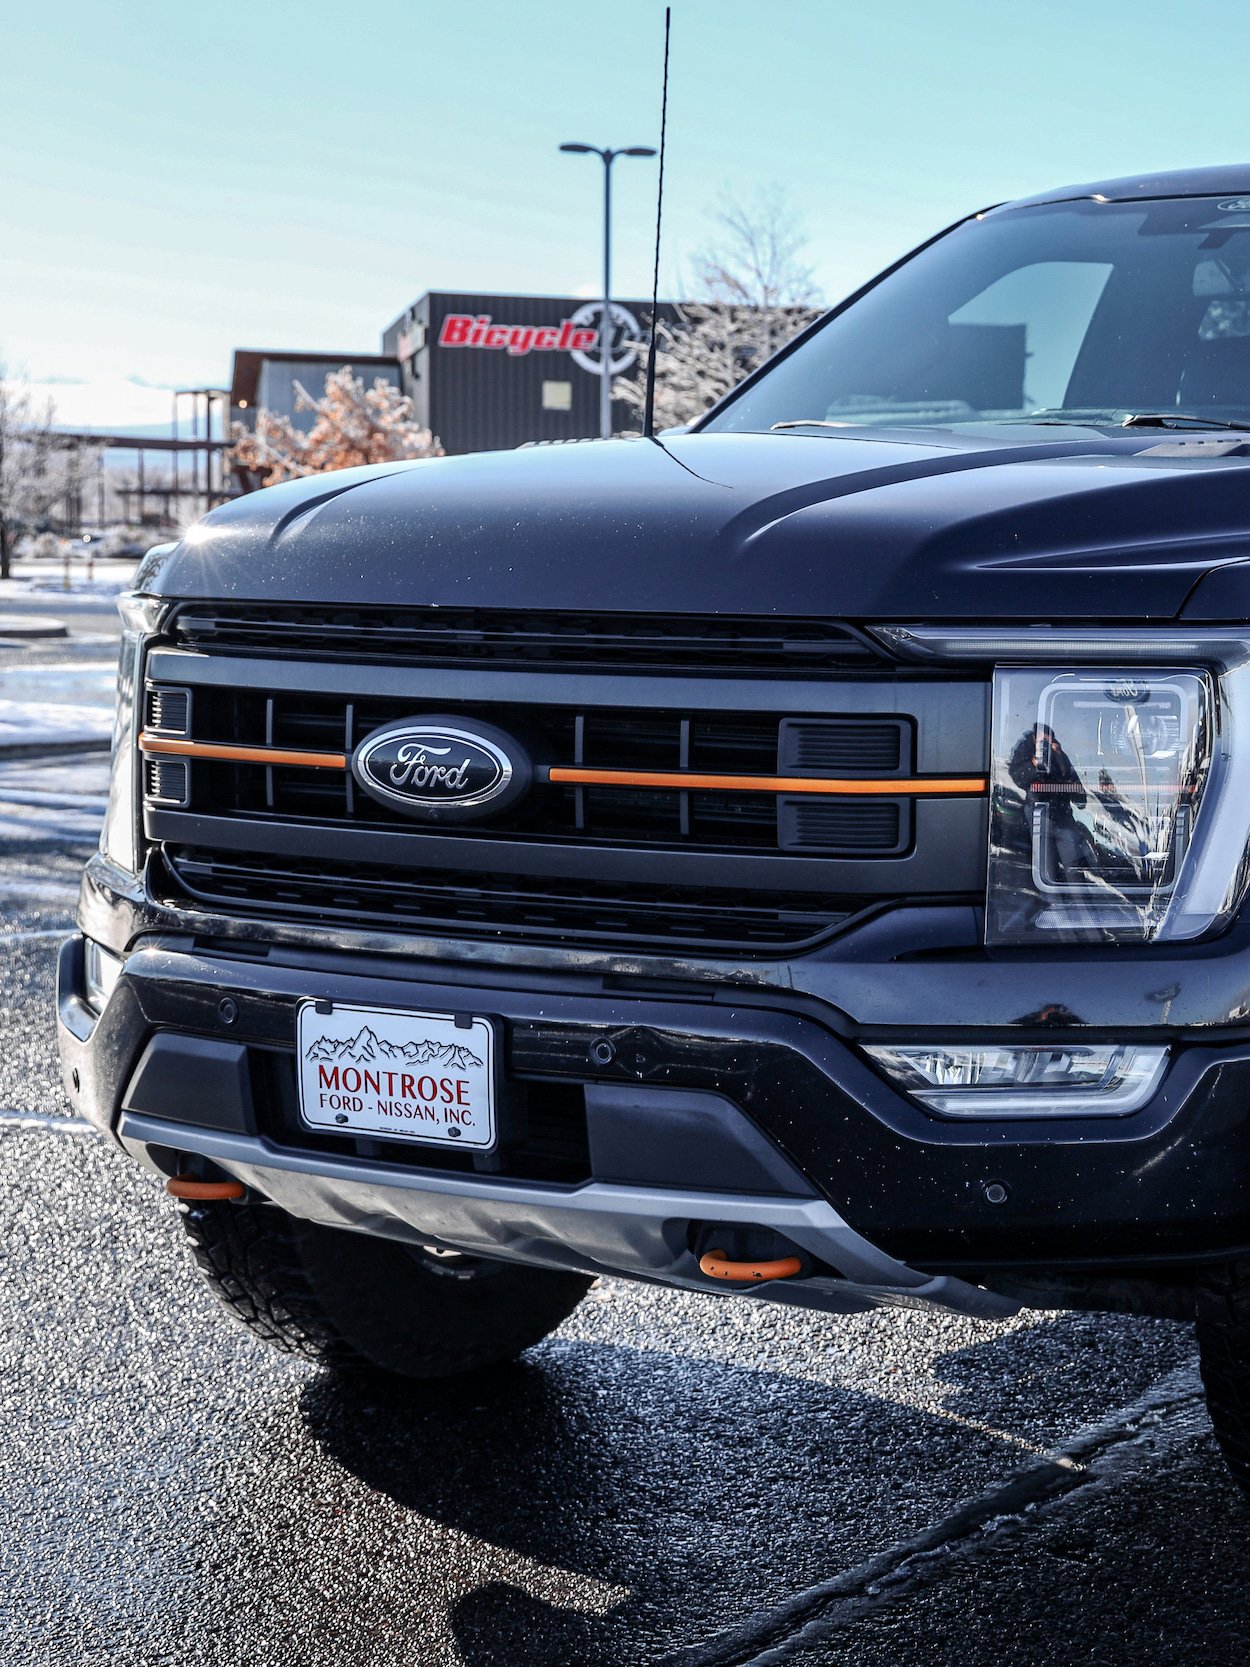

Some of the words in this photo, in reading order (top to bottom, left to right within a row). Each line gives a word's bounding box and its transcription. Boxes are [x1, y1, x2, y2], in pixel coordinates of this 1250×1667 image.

[438, 314, 598, 356] Bicycle
[390, 743, 471, 789] Ford
[318, 1064, 470, 1106] MONTROSE
[320, 1093, 363, 1112] FORD
[378, 1100, 440, 1126] NISSAN,
[444, 1108, 476, 1127] INC.
